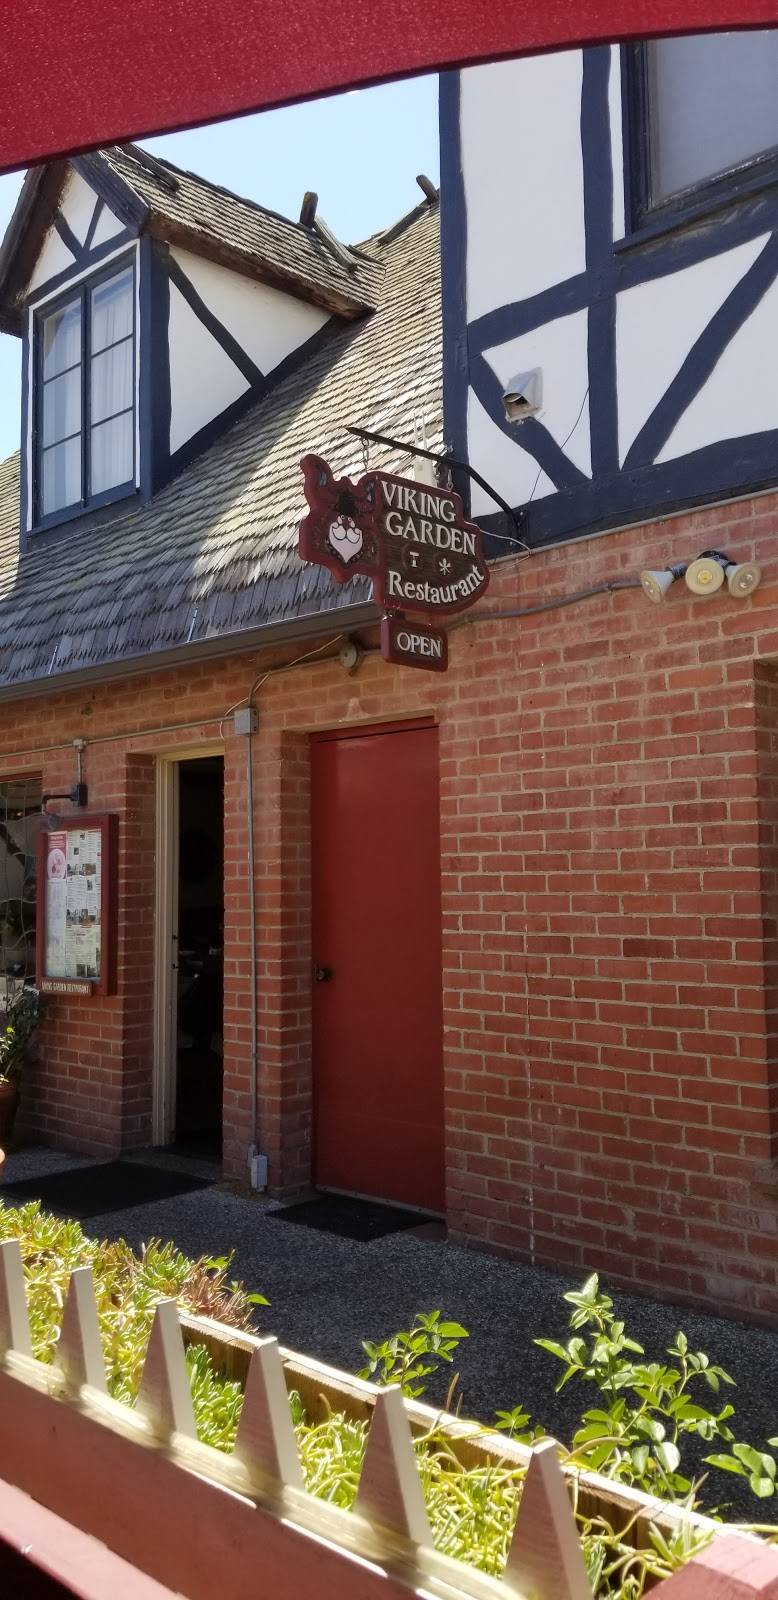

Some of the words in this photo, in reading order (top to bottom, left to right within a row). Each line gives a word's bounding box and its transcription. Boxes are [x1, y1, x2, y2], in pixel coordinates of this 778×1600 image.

[381, 481, 456, 522] VIKING
[386, 512, 476, 555] GARDEN
[389, 566, 484, 604] Restaurant
[396, 632, 441, 657] OPEN
